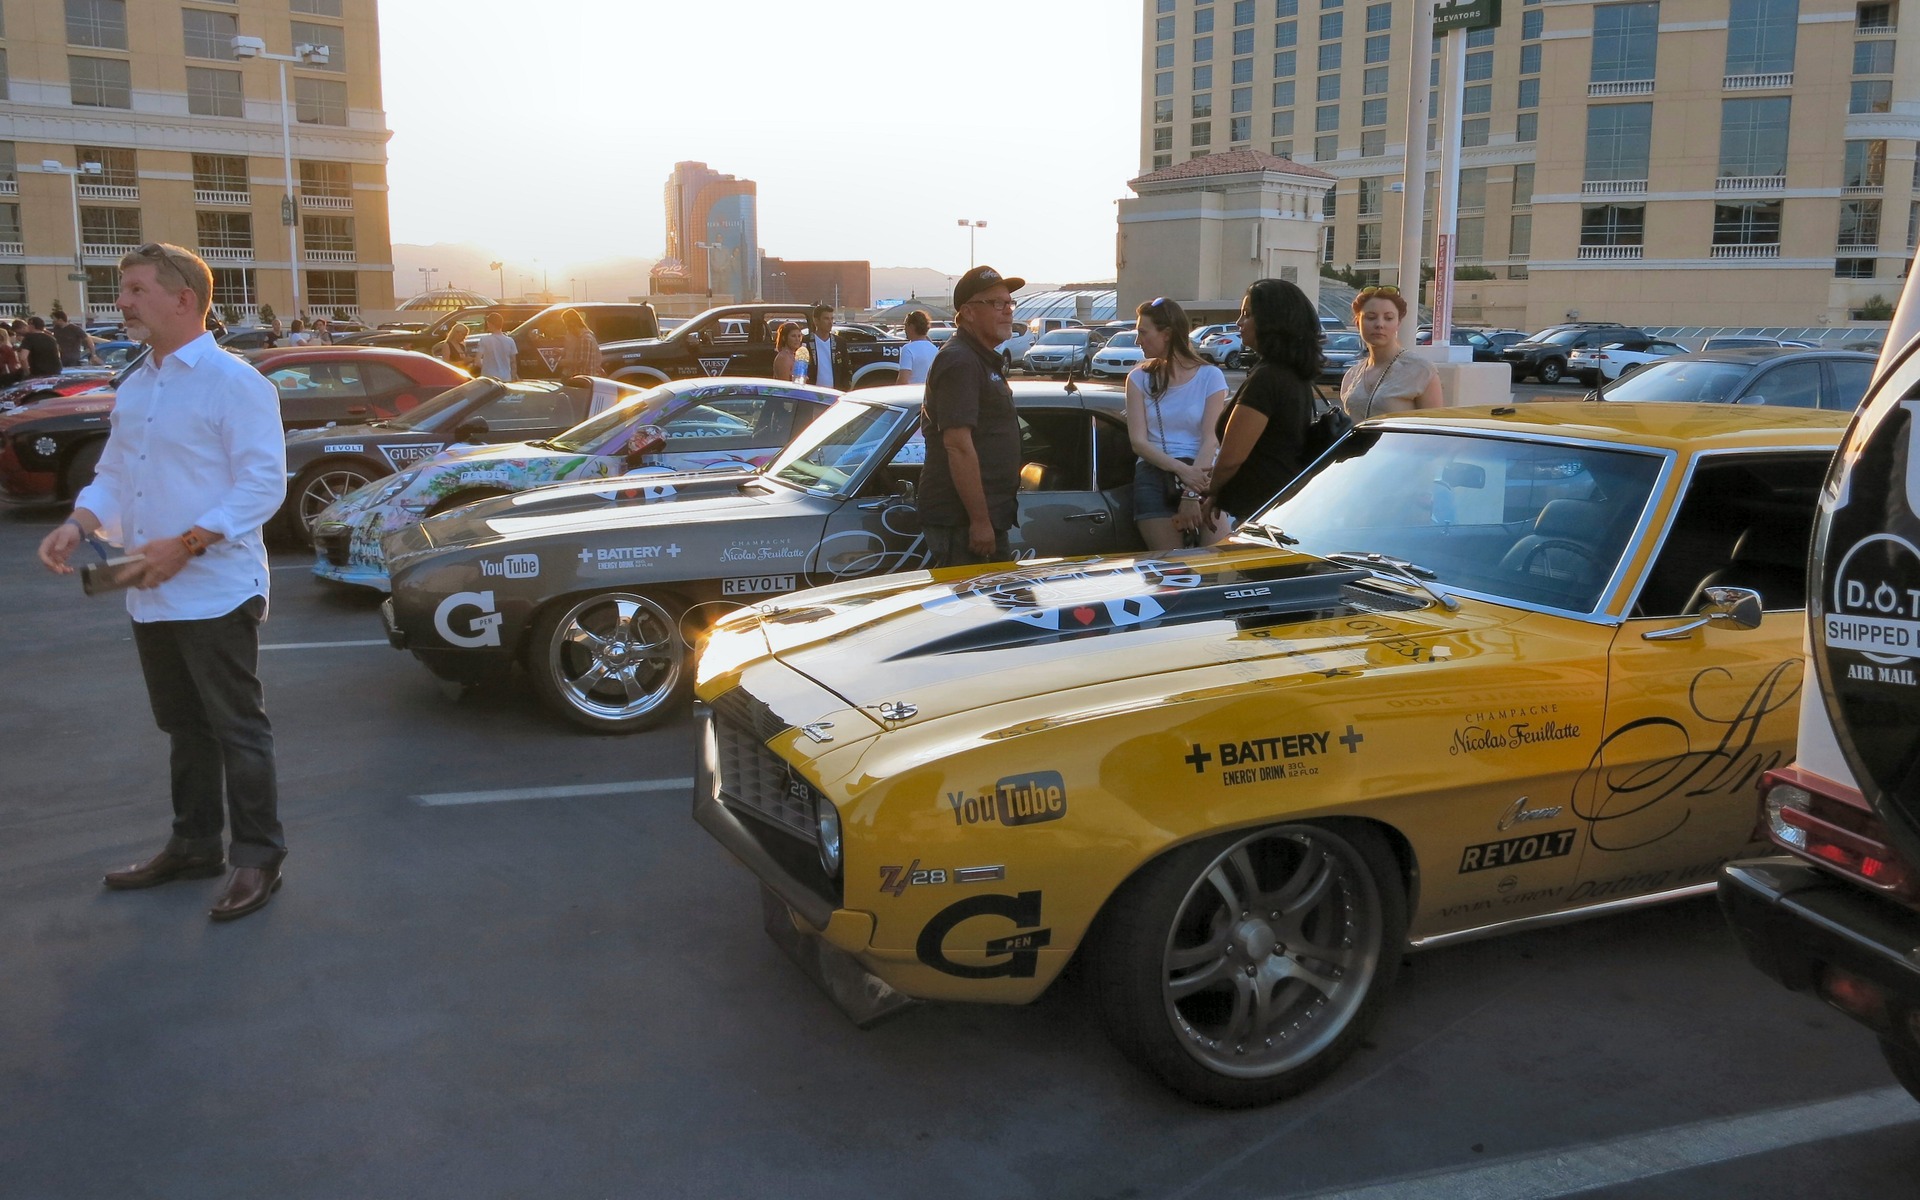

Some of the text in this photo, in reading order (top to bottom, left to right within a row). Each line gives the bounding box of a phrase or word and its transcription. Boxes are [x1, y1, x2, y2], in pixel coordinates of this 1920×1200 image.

[1433, 10, 1481, 24] ELEVATORS
[325, 445, 363, 453] REVOLT
[597, 545, 663, 561] BATTERY
[731, 538, 792, 547] CHAMPAGNE
[597, 561, 619, 570] ENERGY
[618, 560, 635, 569] DRINK
[720, 546, 804, 563] Nicolas Feuillatte
[480, 555, 539, 578] YouTube
[724, 576, 794, 593] REVOLT
[1224, 587, 1271, 599] 302
[1828, 621, 1909, 647] SHIPPED
[1847, 664, 1917, 686] AIR MAIL
[1465, 703, 1559, 724] CHAMPAGNE
[1219, 731, 1330, 766] BATTERY
[1449, 720, 1581, 756] Nicolas Feuillatte
[1223, 764, 1286, 787] ENERGY DRINK
[947, 773, 1066, 826] YouTube
[1461, 830, 1574, 872] REVOLT
[879, 858, 948, 897] Z/28
[1005, 935, 1033, 950] PEN
